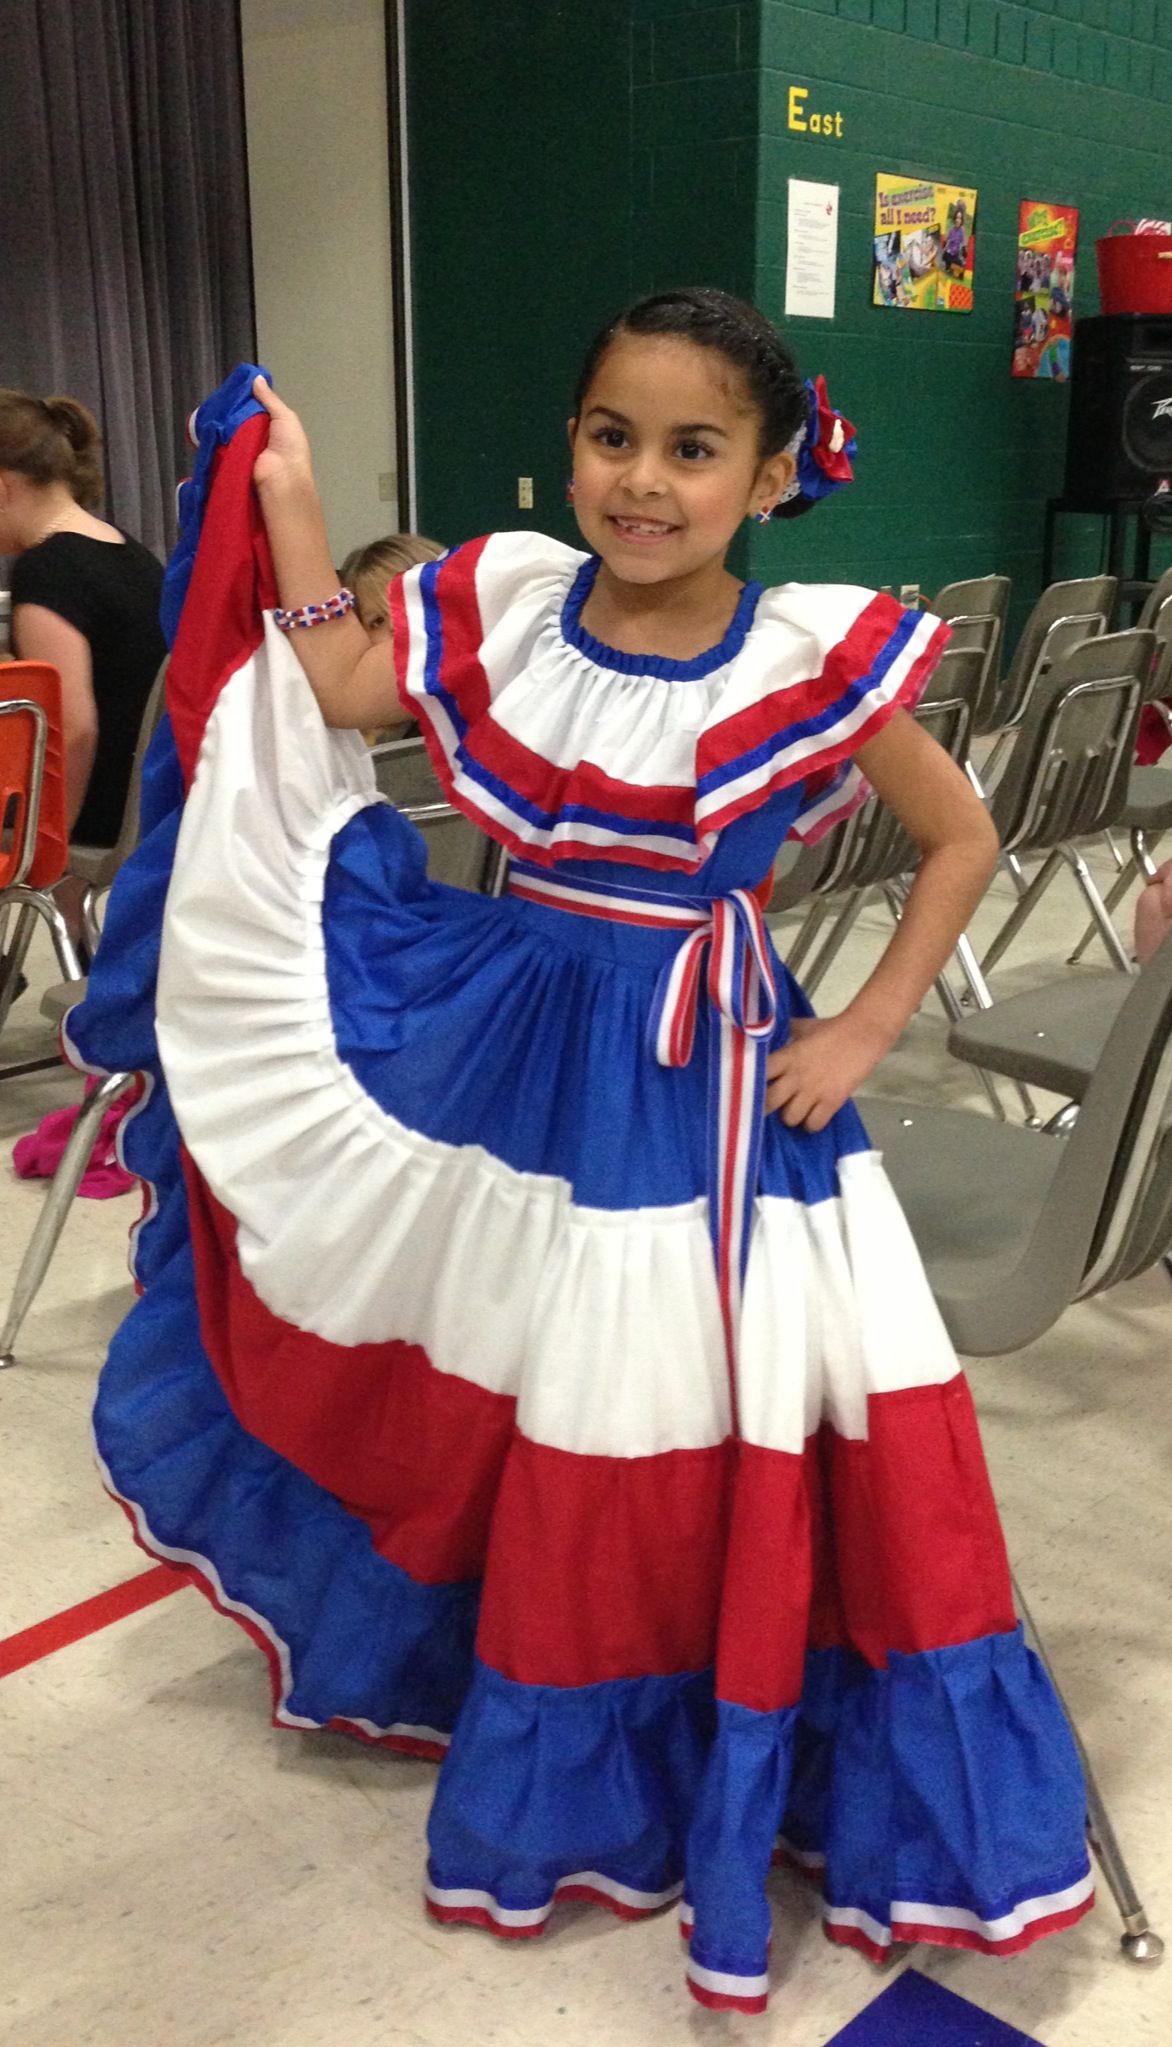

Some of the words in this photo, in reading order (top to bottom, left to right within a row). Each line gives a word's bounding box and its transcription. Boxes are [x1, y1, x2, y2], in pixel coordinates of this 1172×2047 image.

[788, 86, 844, 138] East
[878, 192, 889, 208] Is
[880, 208, 894, 225] all
[896, 209, 902, 225] I
[904, 207, 936, 225] need?
